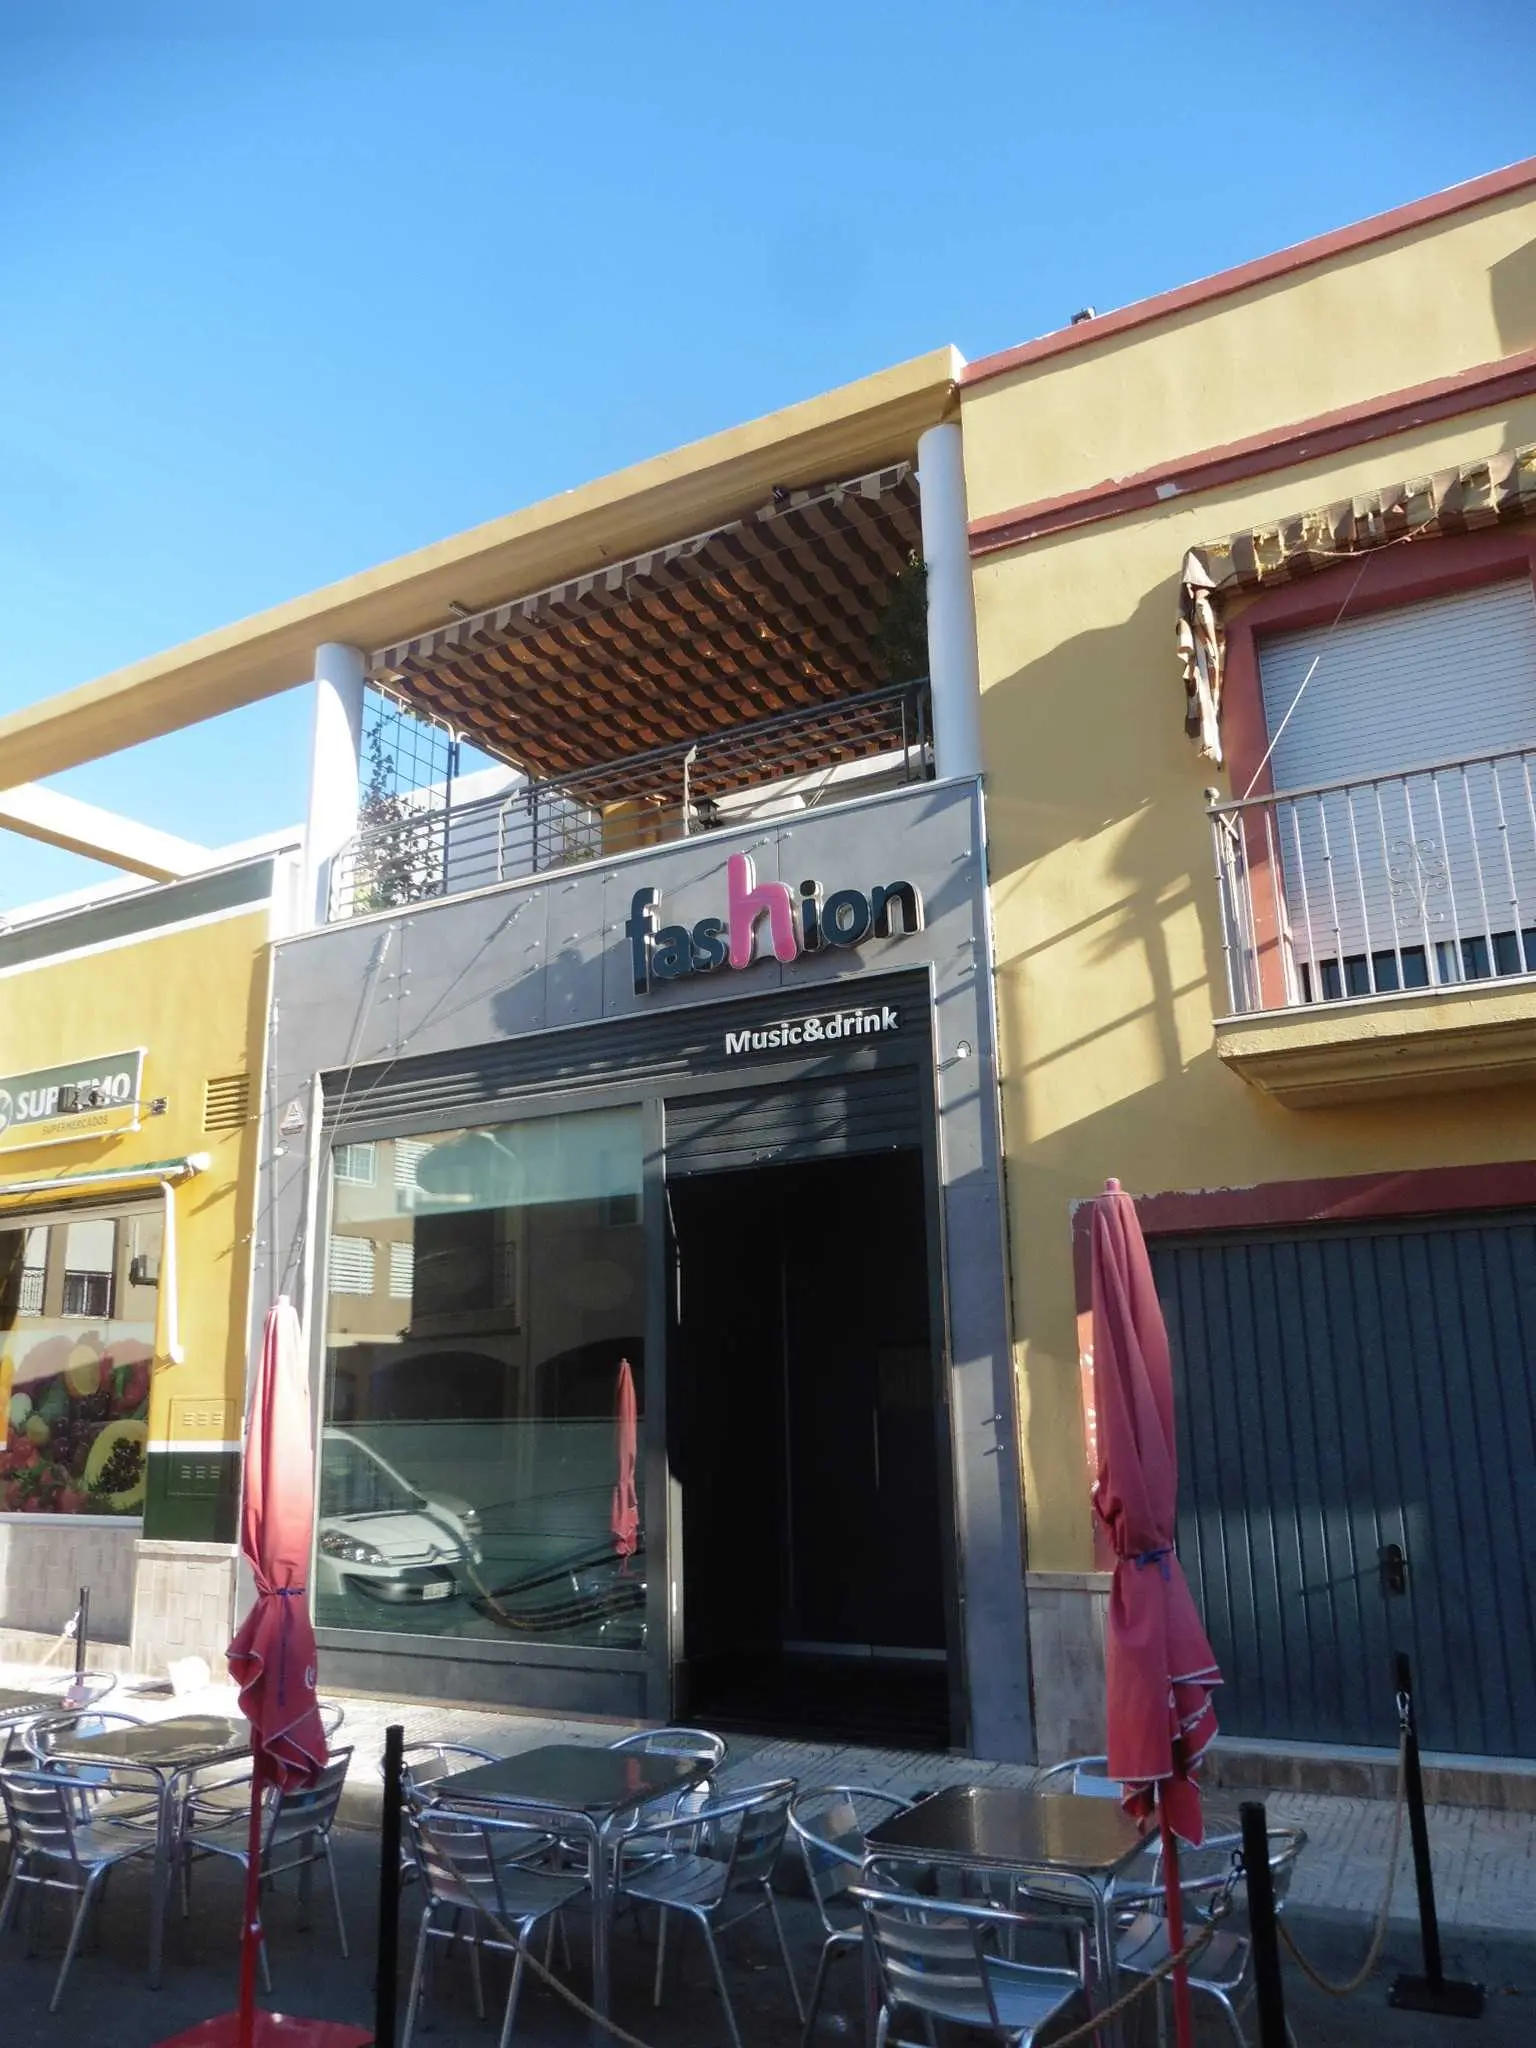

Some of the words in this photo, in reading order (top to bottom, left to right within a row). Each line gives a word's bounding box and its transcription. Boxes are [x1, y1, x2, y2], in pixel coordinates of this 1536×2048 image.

[625, 853, 925, 995] fashion
[725, 1006, 899, 1055] Music&drink
[15, 1072, 131, 1120] SUPMO
